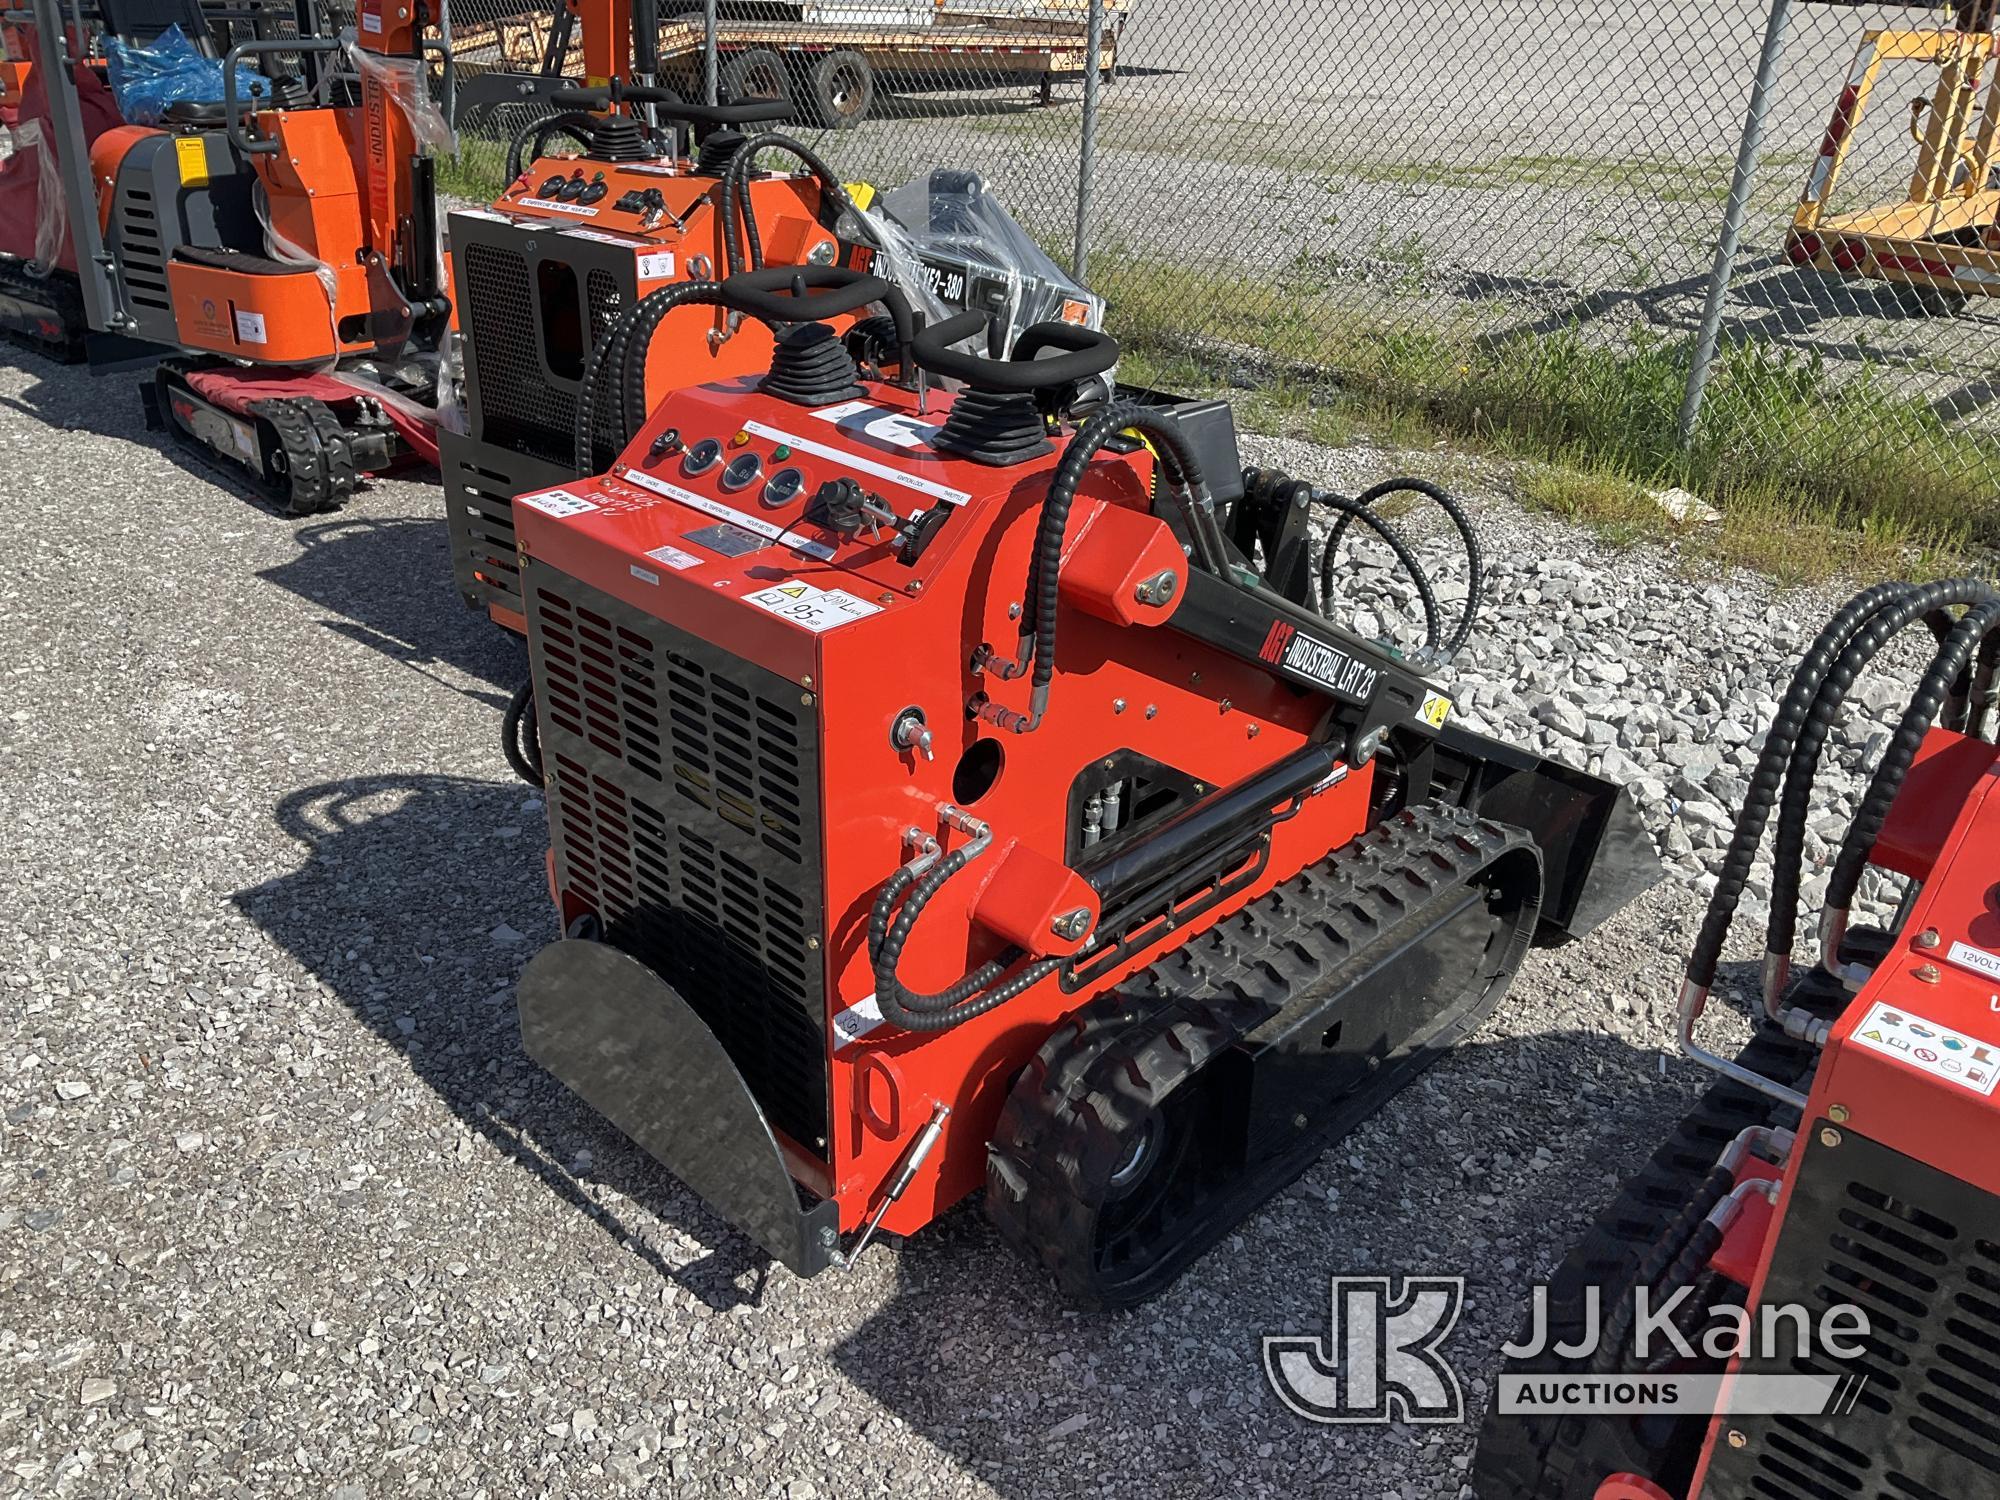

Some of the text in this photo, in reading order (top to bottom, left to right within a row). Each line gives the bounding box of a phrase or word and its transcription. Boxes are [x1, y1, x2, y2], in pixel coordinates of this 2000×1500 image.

[848, 243, 873, 273] AGT
[783, 604, 824, 620] 95
[1258, 619, 1377, 700] AGT INDUSTRIAL LRT 23
